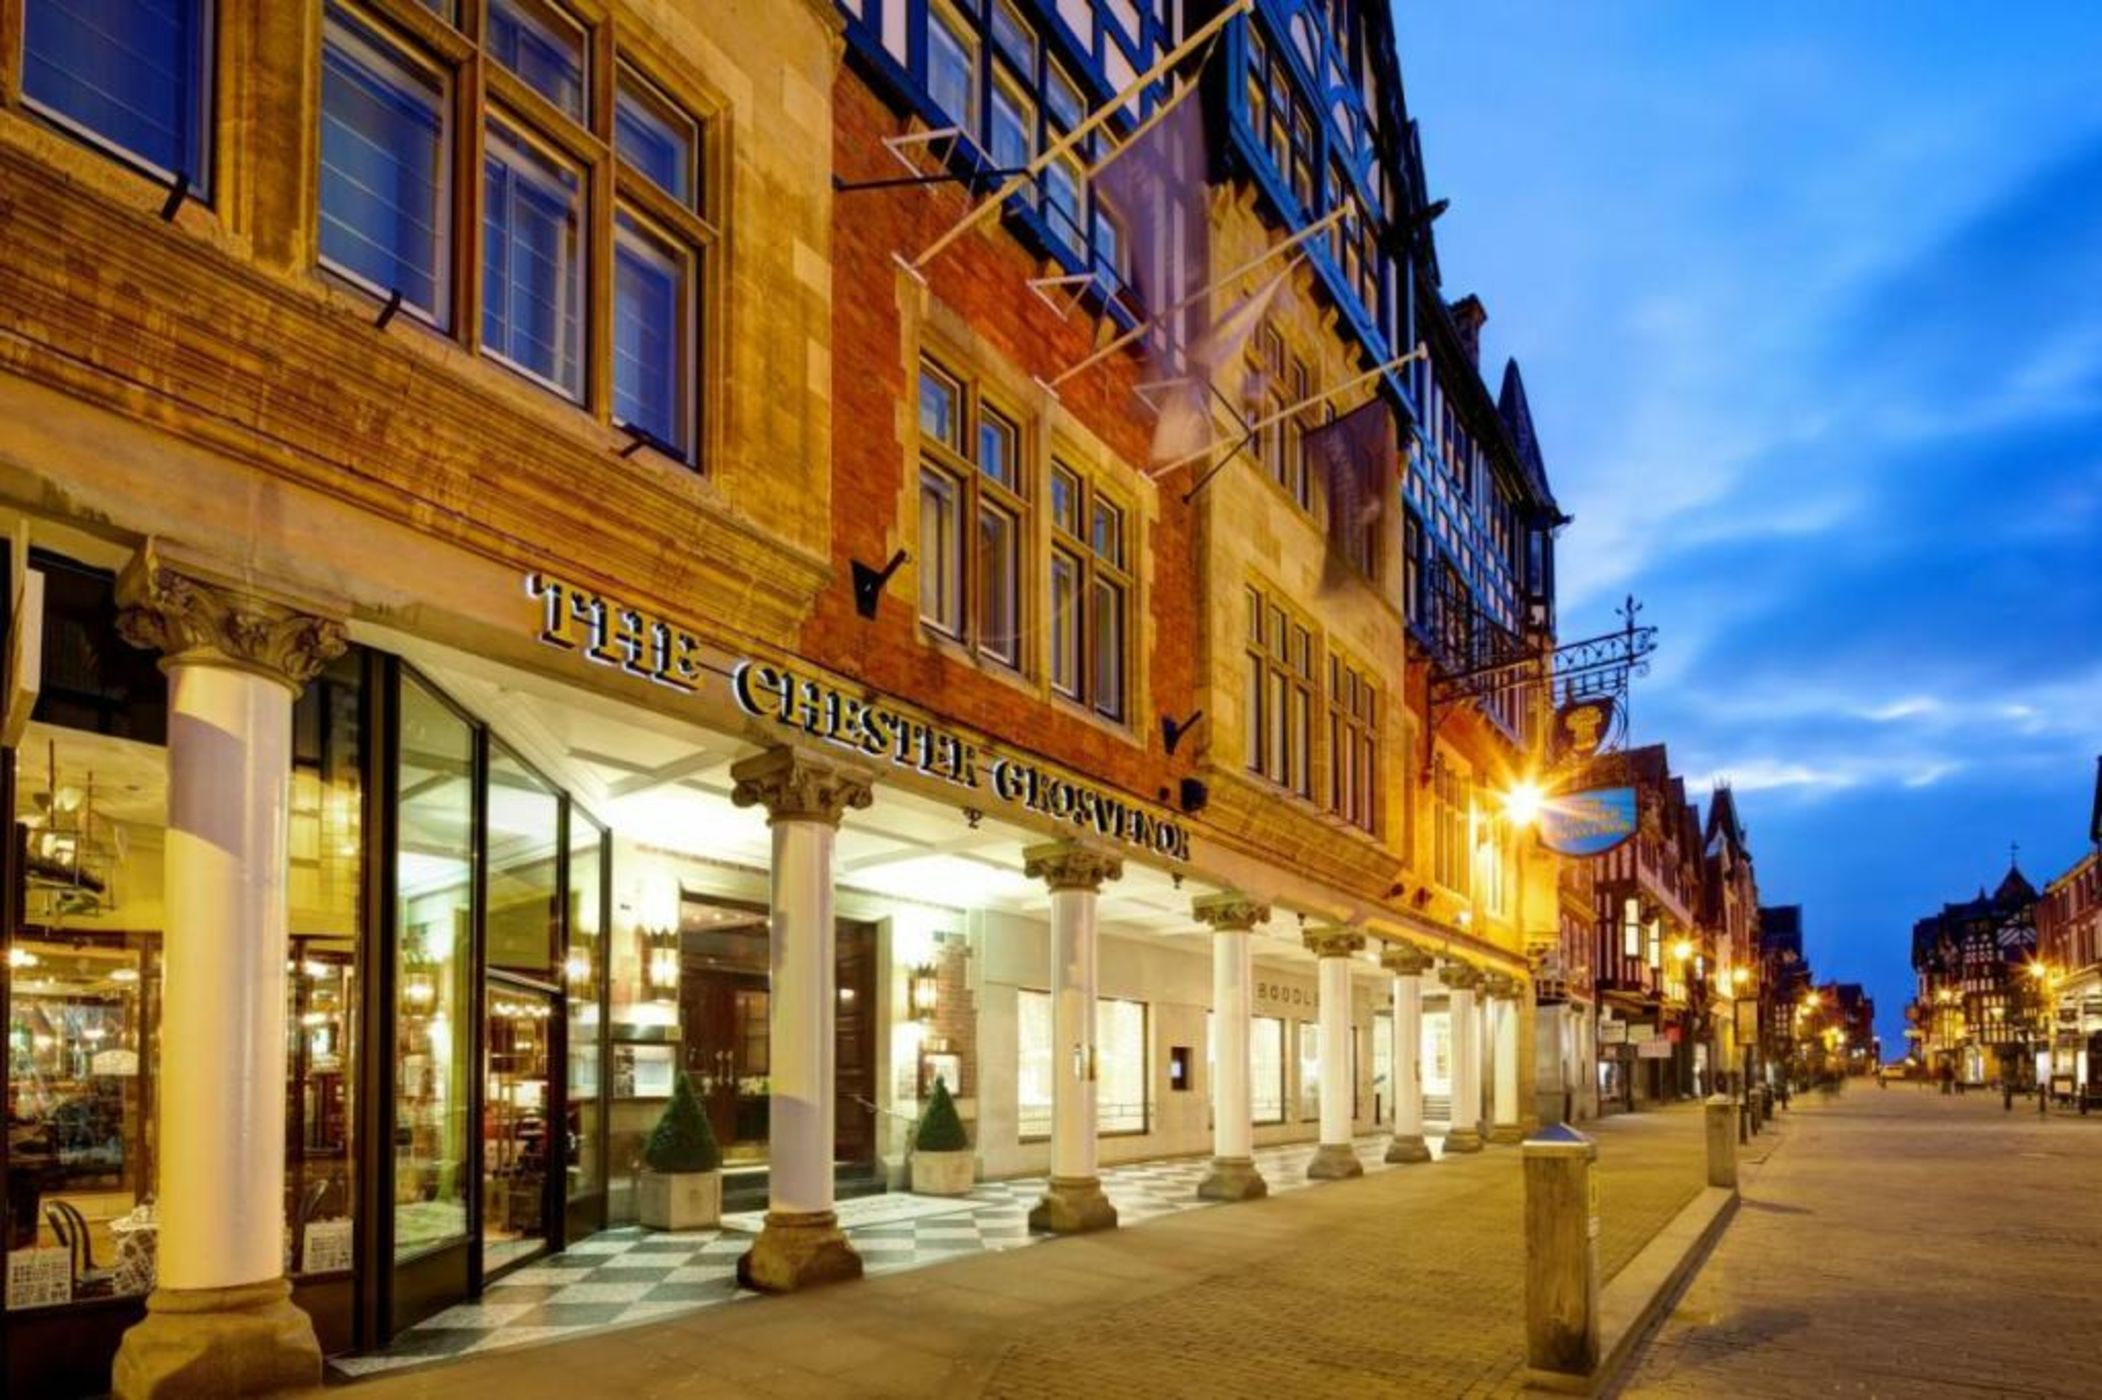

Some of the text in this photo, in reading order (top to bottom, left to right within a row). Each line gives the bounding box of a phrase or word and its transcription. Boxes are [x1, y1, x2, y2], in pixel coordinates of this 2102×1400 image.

[526, 571, 1190, 862] THE CHESTER GROSVENOR
